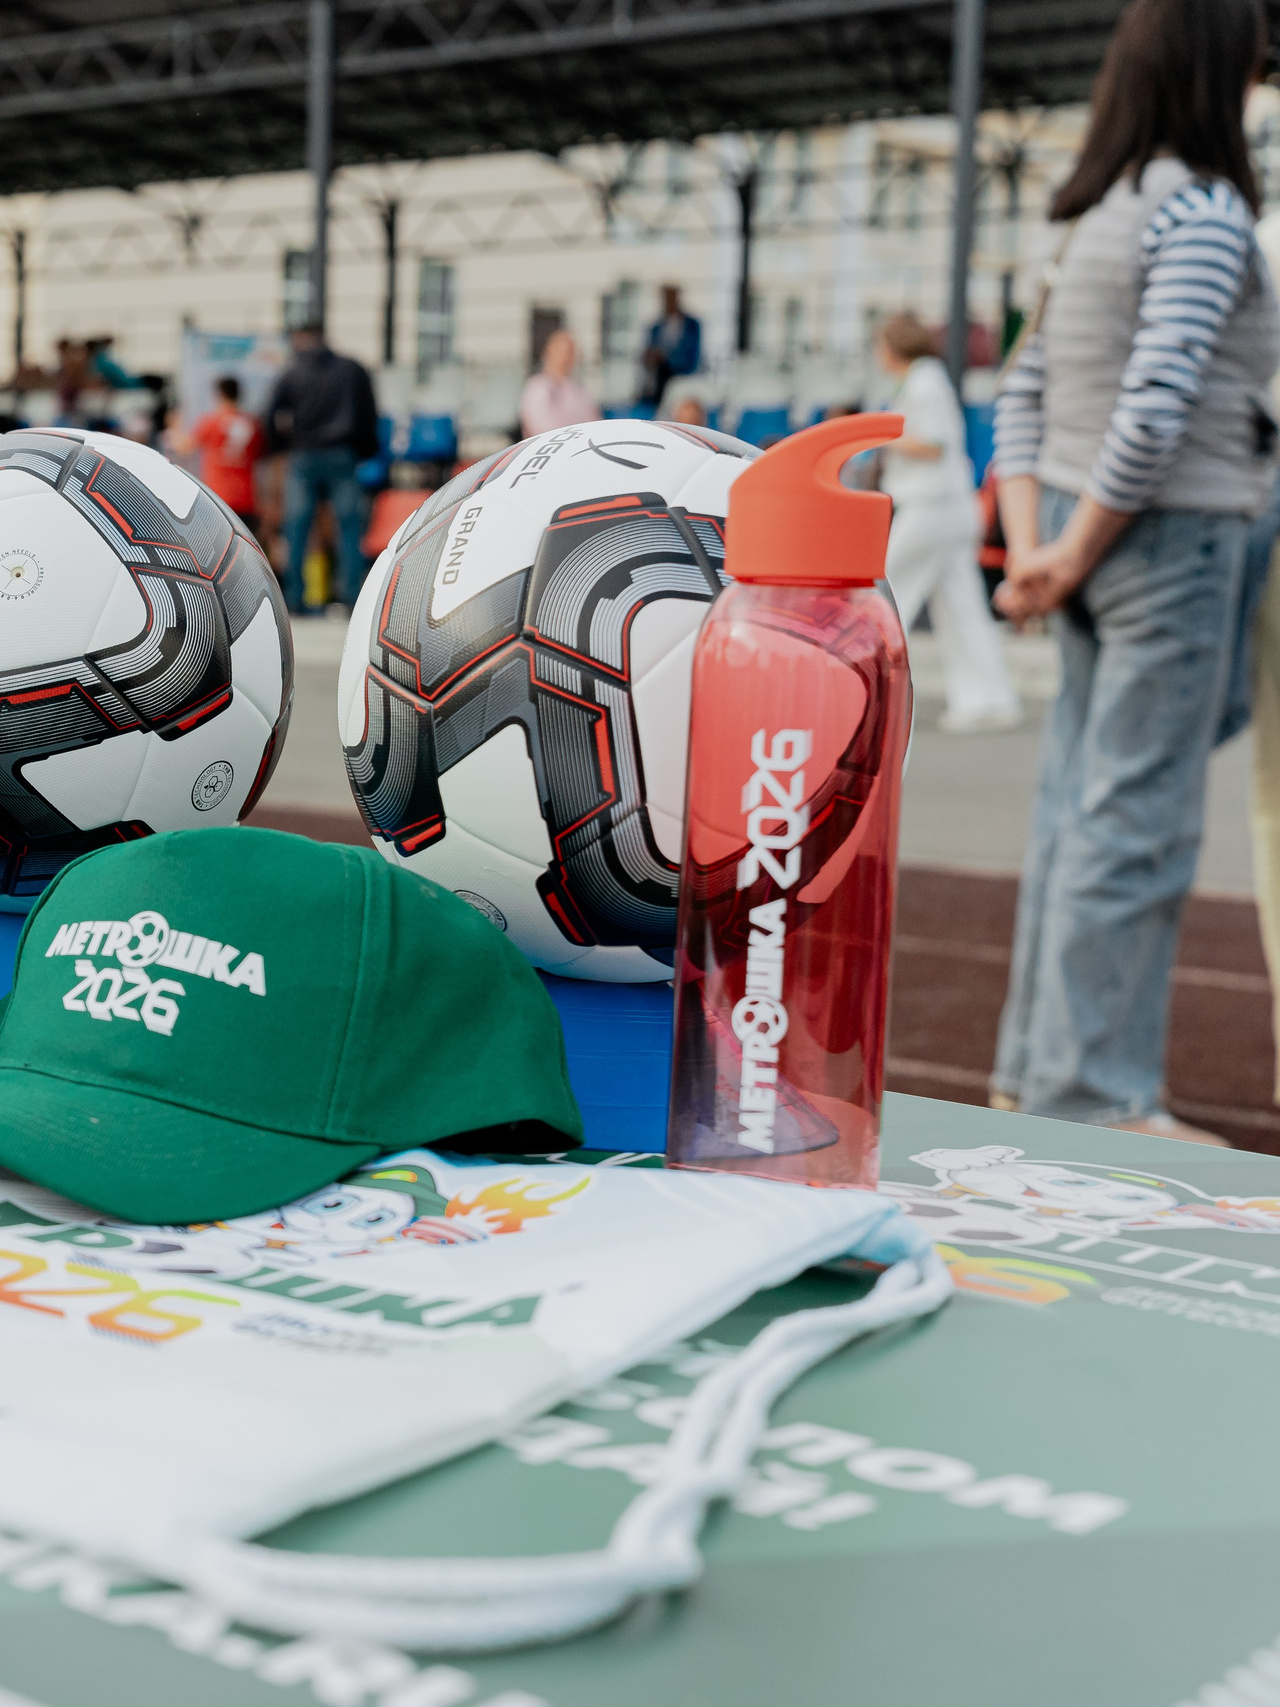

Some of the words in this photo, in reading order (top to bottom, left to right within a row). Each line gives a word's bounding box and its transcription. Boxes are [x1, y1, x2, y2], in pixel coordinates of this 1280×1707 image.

[442, 506, 483, 586] GRAND
[736, 728, 814, 890] 2026
[44, 910, 267, 997] МЕТРОШКА
[62, 959, 187, 1036] 2026
